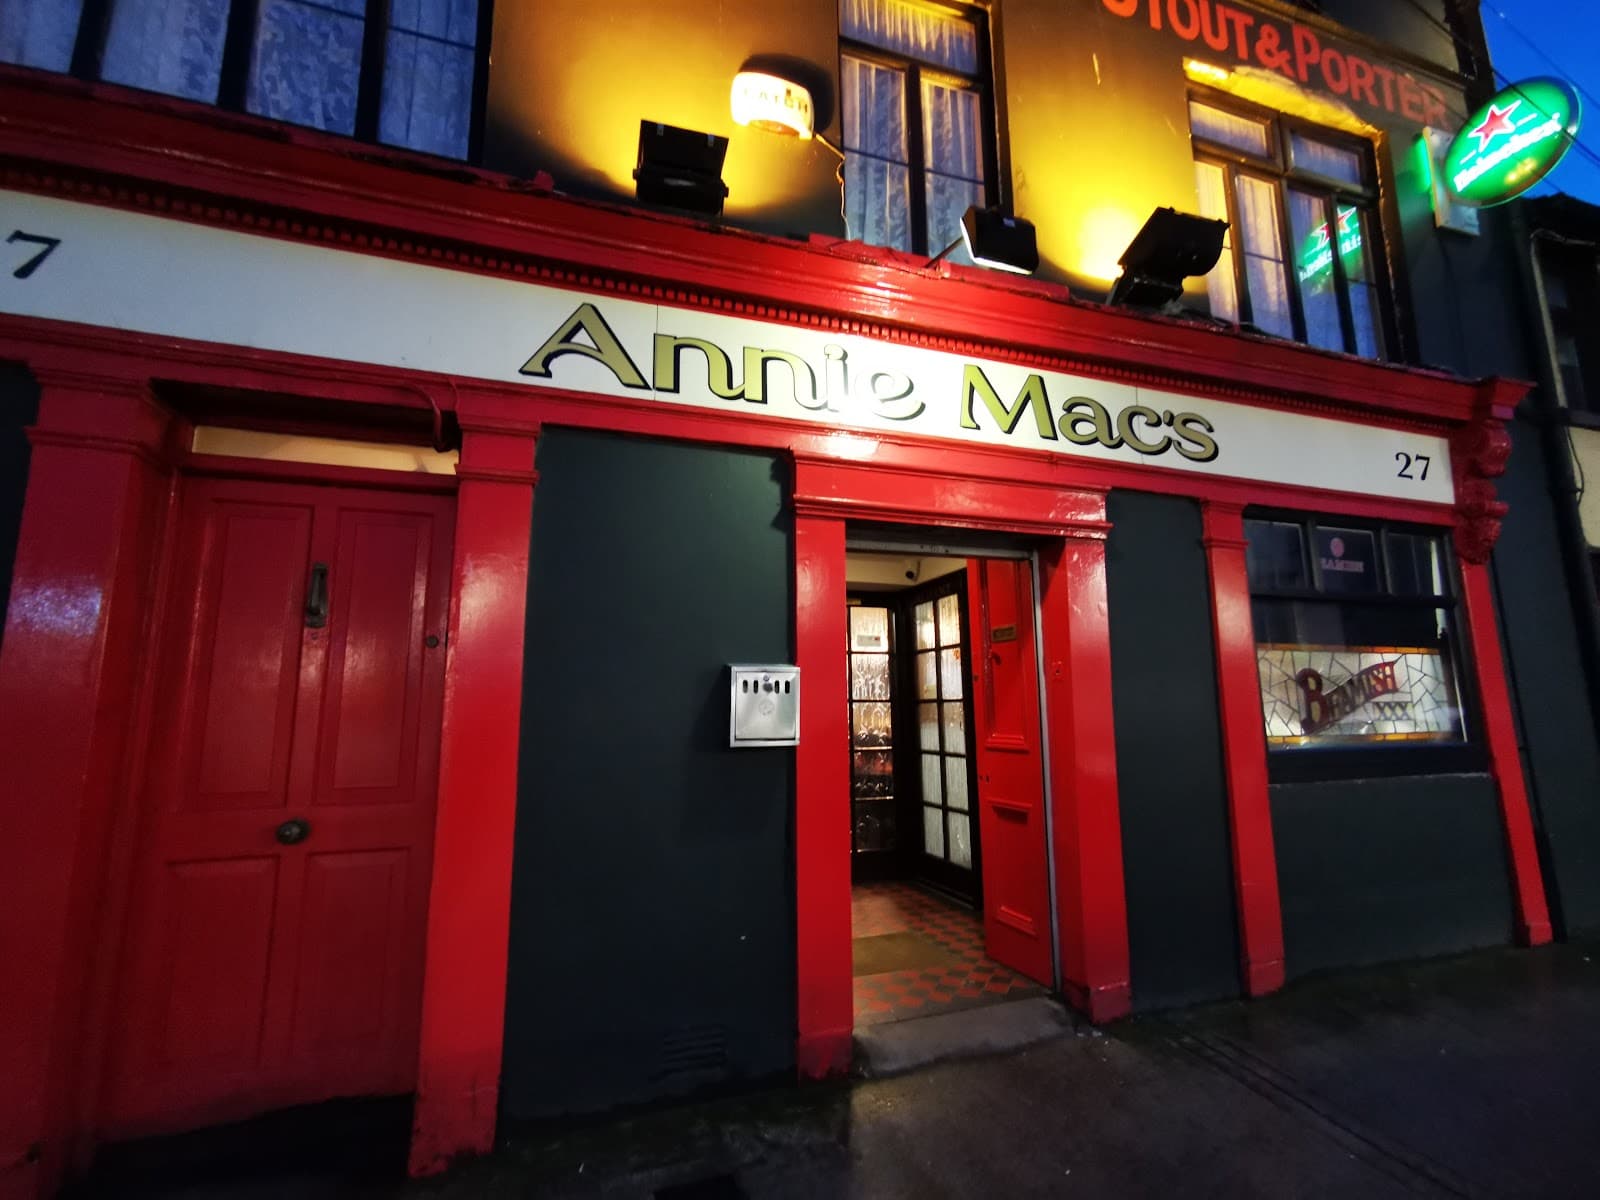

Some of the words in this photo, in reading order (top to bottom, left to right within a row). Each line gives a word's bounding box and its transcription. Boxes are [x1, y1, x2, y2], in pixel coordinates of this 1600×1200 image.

[1292, 22, 1452, 132] PORTER
[5, 229, 63, 280] 7
[518, 302, 926, 420] Annie
[959, 363, 1220, 462] Mac's
[1395, 451, 1431, 481] 27
